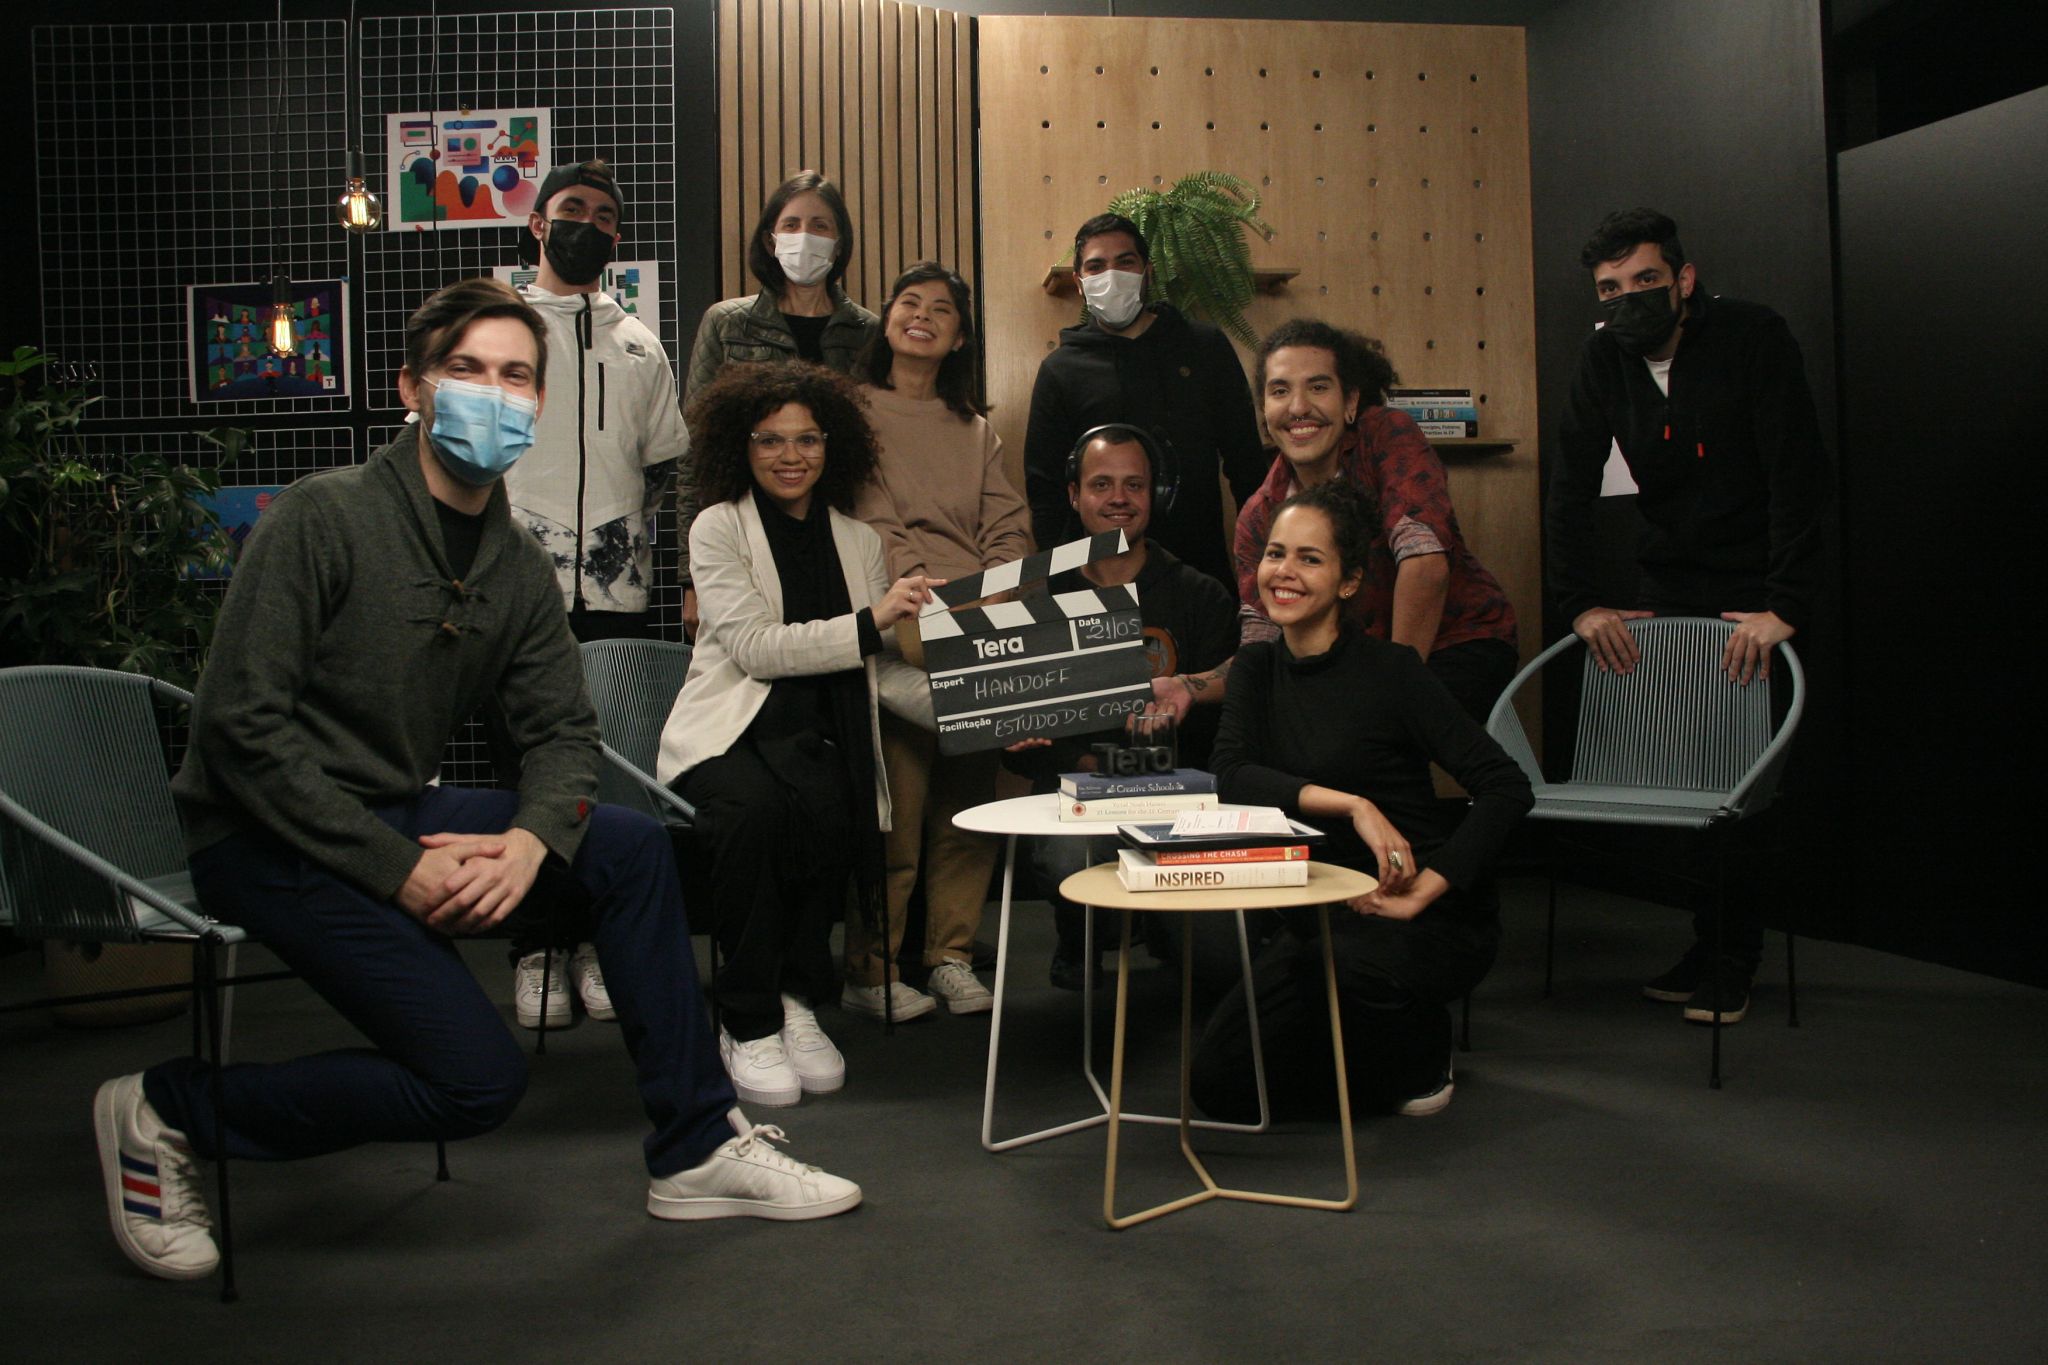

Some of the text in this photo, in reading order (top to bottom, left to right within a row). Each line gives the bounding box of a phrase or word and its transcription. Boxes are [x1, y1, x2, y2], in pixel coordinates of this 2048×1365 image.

[1078, 617, 1100, 627] Data
[1086, 618, 1141, 639] 21/05
[973, 636, 1024, 659] Tera
[932, 677, 965, 690] Expert
[975, 668, 1072, 700] HANDOFF
[1098, 699, 1145, 717] CASO
[939, 718, 991, 733] Facilitação
[1116, 782, 1174, 793] Creative Schools
[1203, 850, 1218, 858] THE
[1219, 850, 1248, 858] CHASM
[1154, 871, 1225, 887] INSPIRED
